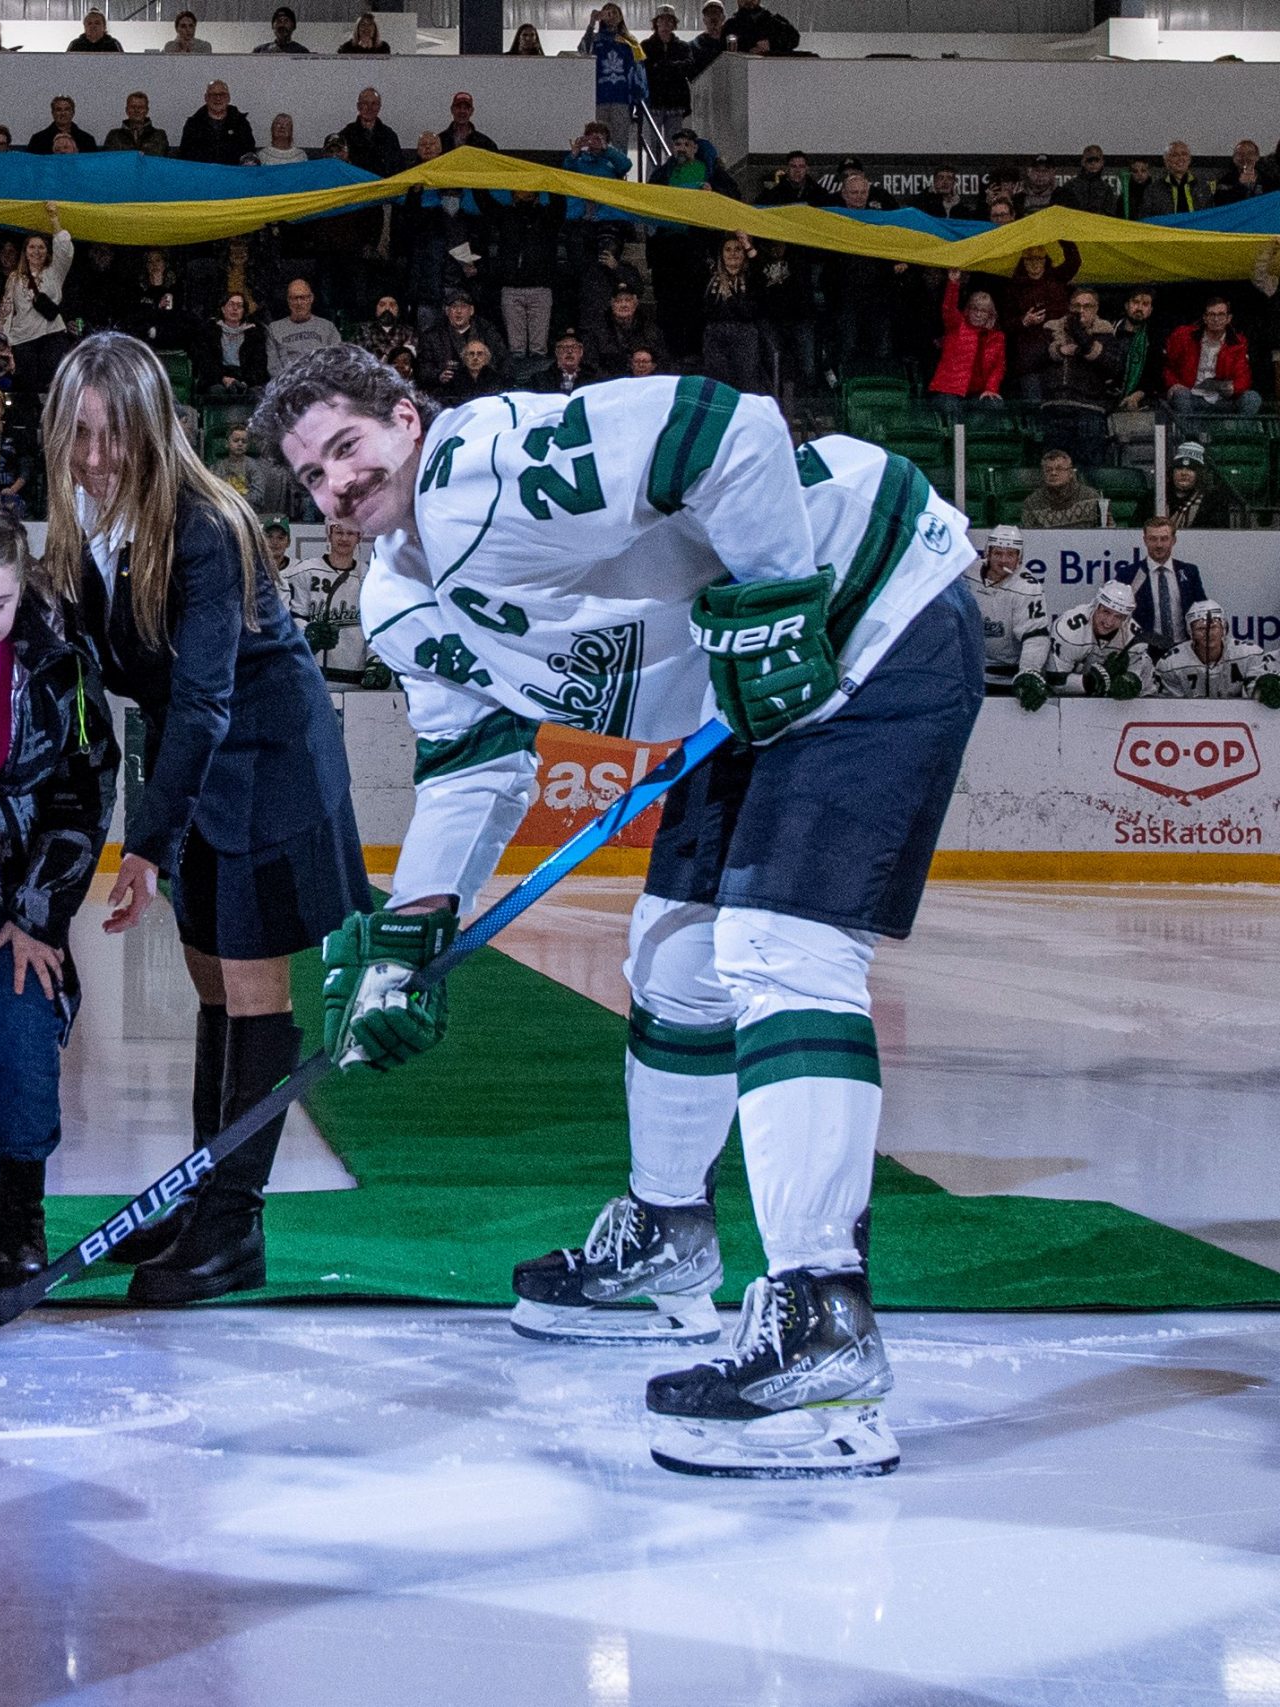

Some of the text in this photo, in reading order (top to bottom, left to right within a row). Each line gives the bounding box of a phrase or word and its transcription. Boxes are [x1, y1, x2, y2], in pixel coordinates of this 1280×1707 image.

[519, 396, 607, 521] 22
[310, 575, 332, 594] 28
[449, 587, 531, 637] C
[1027, 600, 1046, 619] 12
[1114, 818, 1262, 846] Saskatoon
